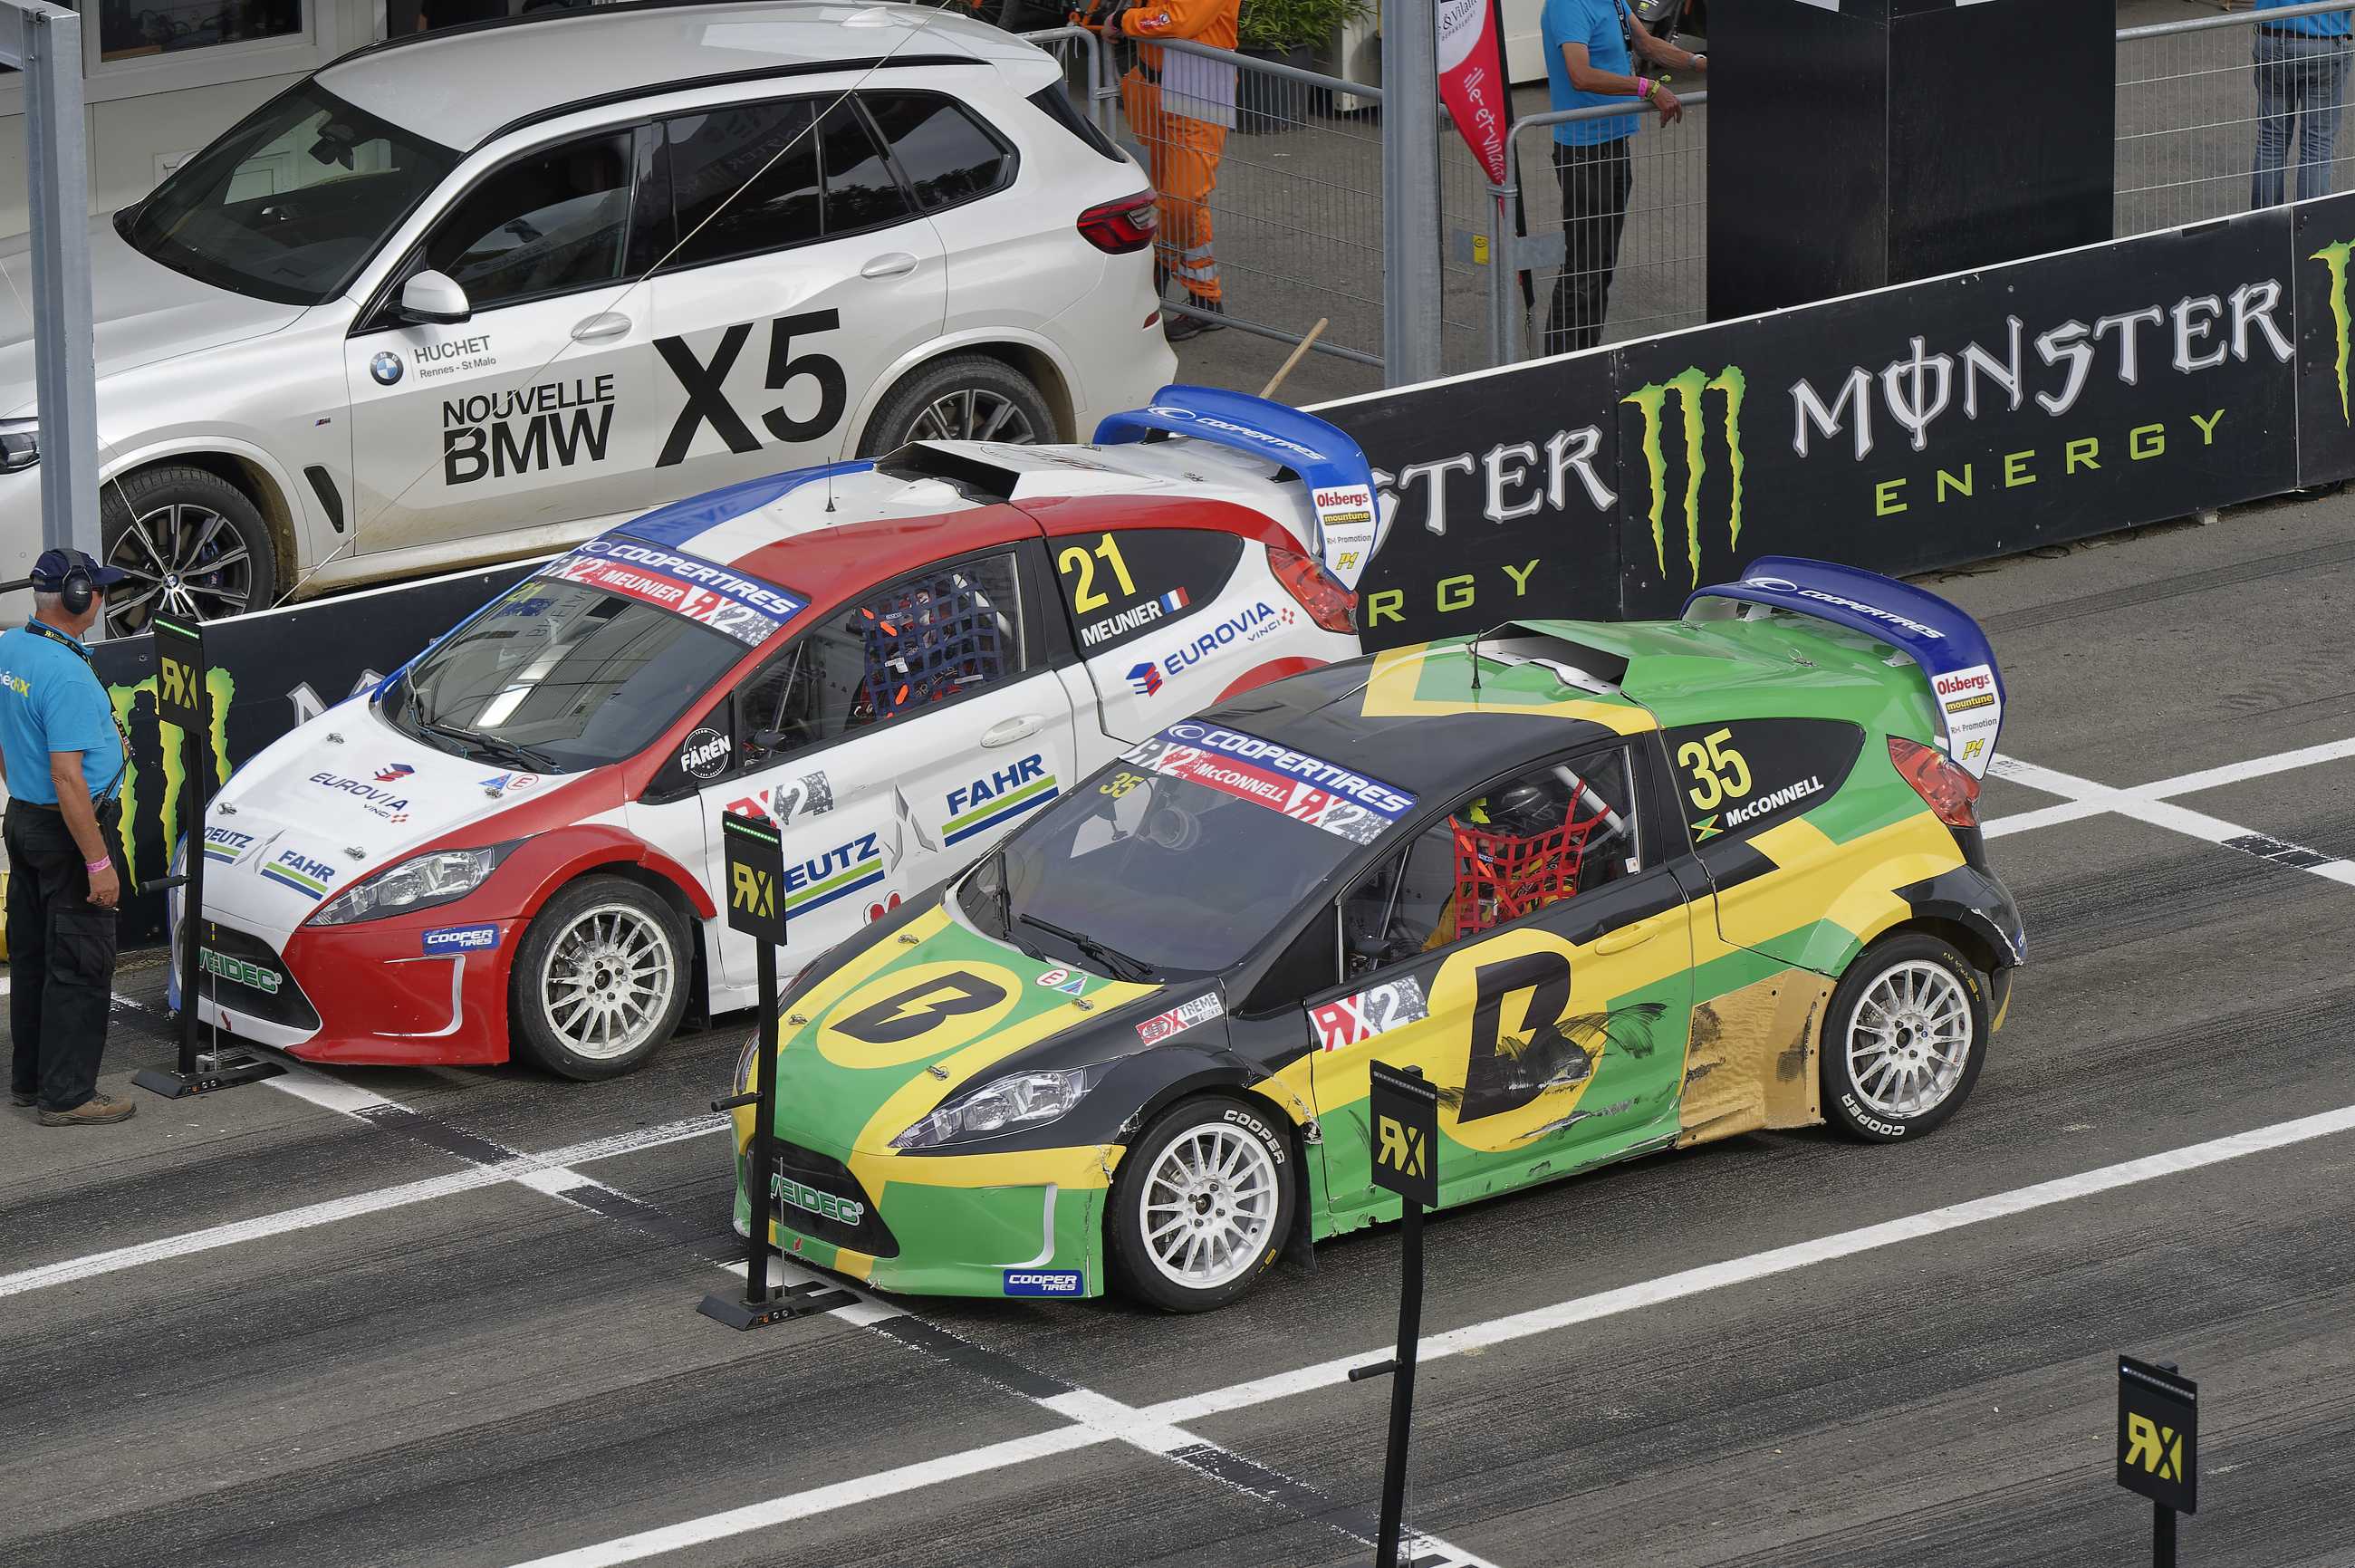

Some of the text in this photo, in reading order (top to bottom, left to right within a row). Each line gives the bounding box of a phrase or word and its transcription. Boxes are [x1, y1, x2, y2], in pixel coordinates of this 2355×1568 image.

[414, 335, 490, 363] HUCHET
[419, 366, 454, 379] Rennes
[461, 361, 473, 370] St
[474, 357, 496, 368] Malo
[1787, 278, 2296, 462] MONSTER
[443, 374, 615, 428] NOUVELLE
[444, 308, 848, 486] BMW X5
[1874, 409, 2226, 517] ENERGY
[1317, 492, 1369, 507] Olsbergs
[1324, 512, 1370, 523] mountune
[1337, 534, 1371, 544] Promotion
[600, 569, 686, 602] MEUNIER
[1058, 533, 1137, 615] 21
[1081, 601, 1163, 648] MEUNIER
[1164, 601, 1275, 676] EUROVIA
[1247, 619, 1282, 642] VINCI
[1937, 674, 1990, 696] Olsbergs
[1946, 694, 1994, 711] mountune
[1962, 718, 1997, 731] Promotion
[681, 735, 731, 772] FÄRÉN
[1677, 727, 1752, 810] 35
[946, 754, 1045, 816] FAHR
[1100, 772, 1145, 798] 35
[1197, 763, 1287, 803] McCONNELL
[1201, 729, 1415, 813] COOPERTIRES
[309, 773, 409, 813] EUROVIA
[1725, 775, 1824, 827] McCONNELL
[363, 803, 390, 819] VINCI
[205, 826, 254, 849] DEUTZ
[278, 850, 335, 882] FAHR
[783, 832, 880, 893] EUTZ
[428, 929, 494, 944] COOPER
[458, 938, 493, 947] TIRES
[1841, 1092, 1906, 1136] COOPER
[1224, 1110, 1285, 1165] COOPER
[1008, 1274, 1078, 1285] COOPER
[1042, 1283, 1077, 1292] TIRES
